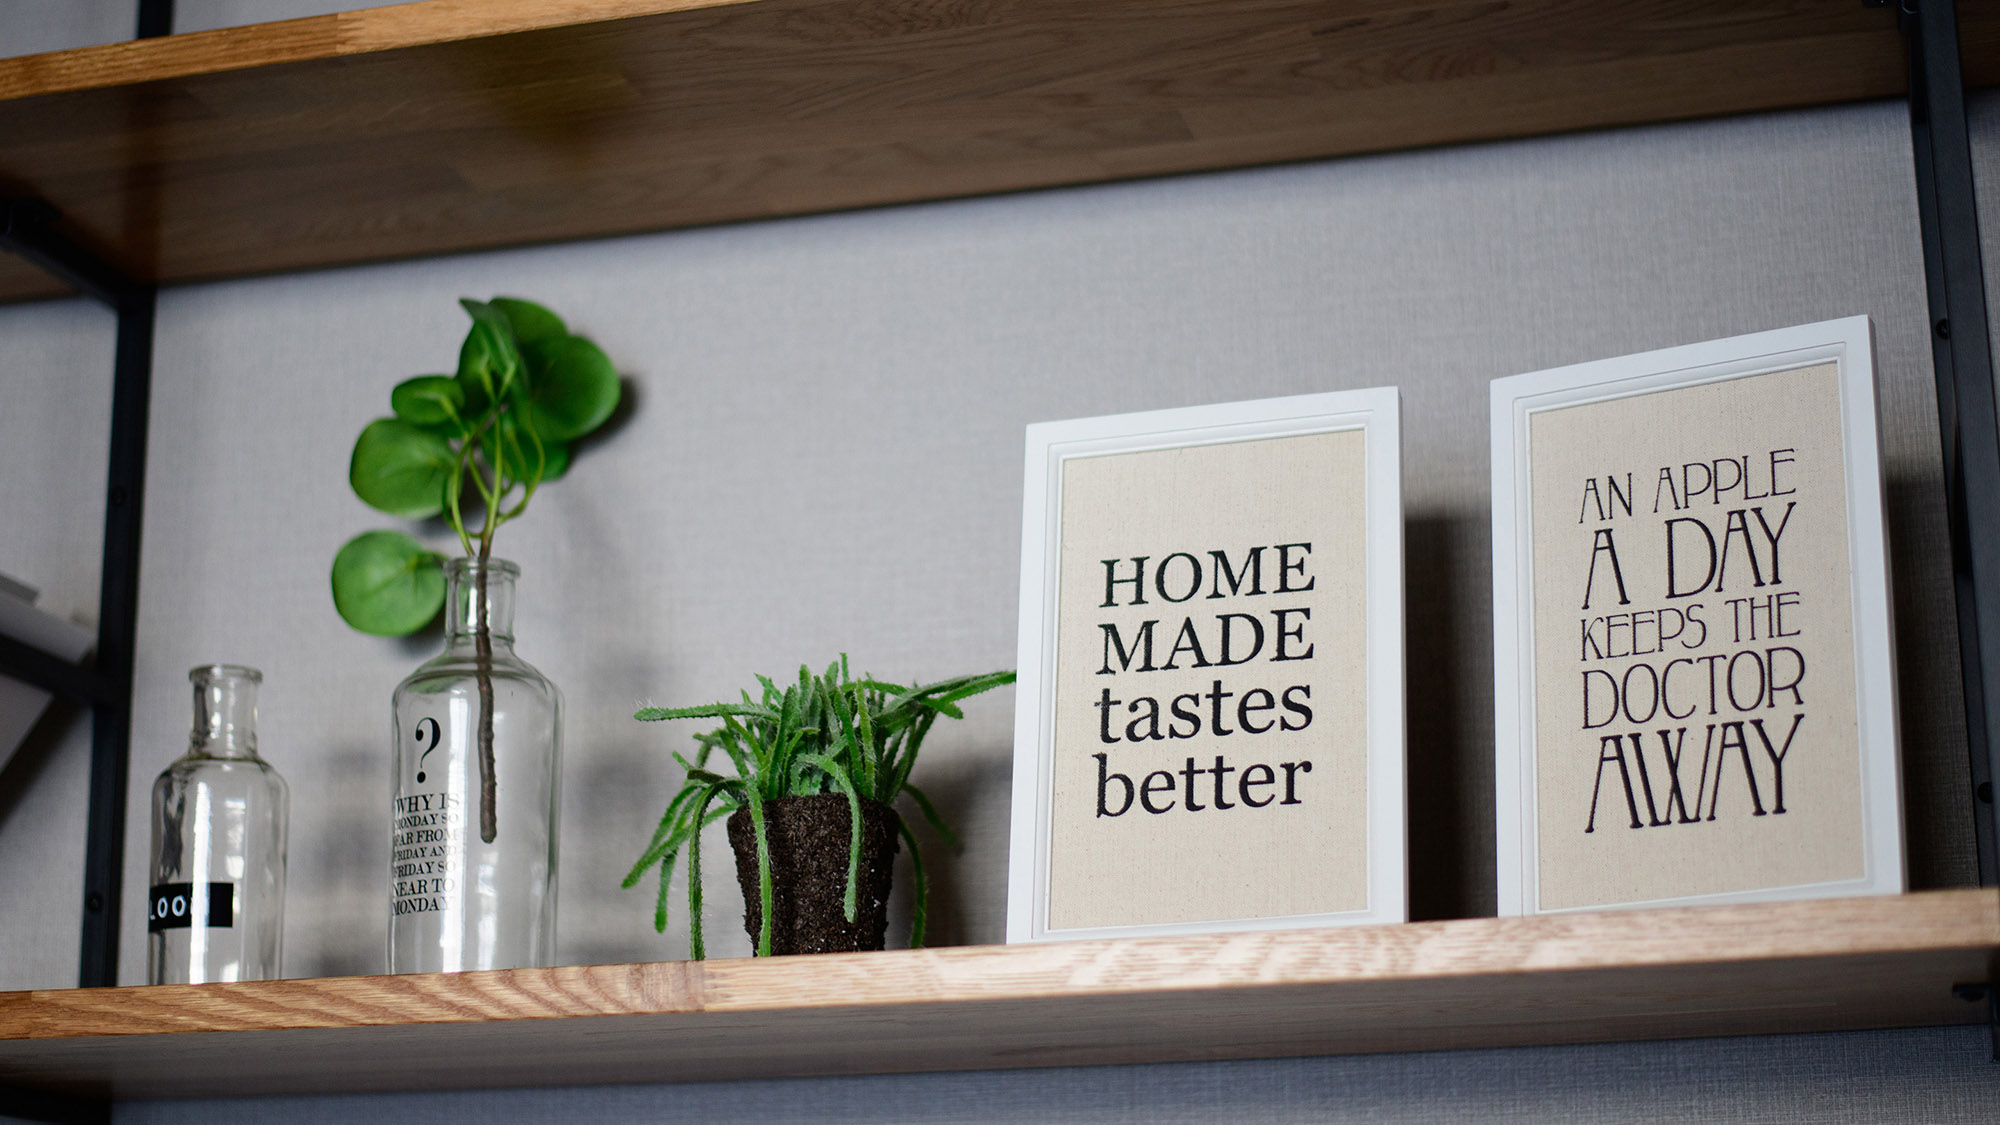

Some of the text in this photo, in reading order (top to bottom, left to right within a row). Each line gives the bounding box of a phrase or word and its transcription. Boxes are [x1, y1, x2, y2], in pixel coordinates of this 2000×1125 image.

[1578, 447, 1797, 524] AN APPLE
[1098, 542, 1316, 608] HOME
[1581, 501, 1797, 611] A DAY
[1095, 607, 1314, 676] MADE
[1580, 591, 1801, 662] KEEPS THE
[1093, 679, 1313, 744] tastes
[1581, 646, 1806, 730] DOCTOR
[415, 717, 441, 783] ?
[1584, 713, 1805, 834] AWAY
[395, 792, 460, 814] WHY IS
[1091, 751, 1313, 819] better
[415, 828, 459, 843] FROM
[442, 812, 459, 825] SO
[394, 845, 457, 861] RIDAY AND
[431, 877, 456, 894] TO
[437, 860, 457, 874] SO
